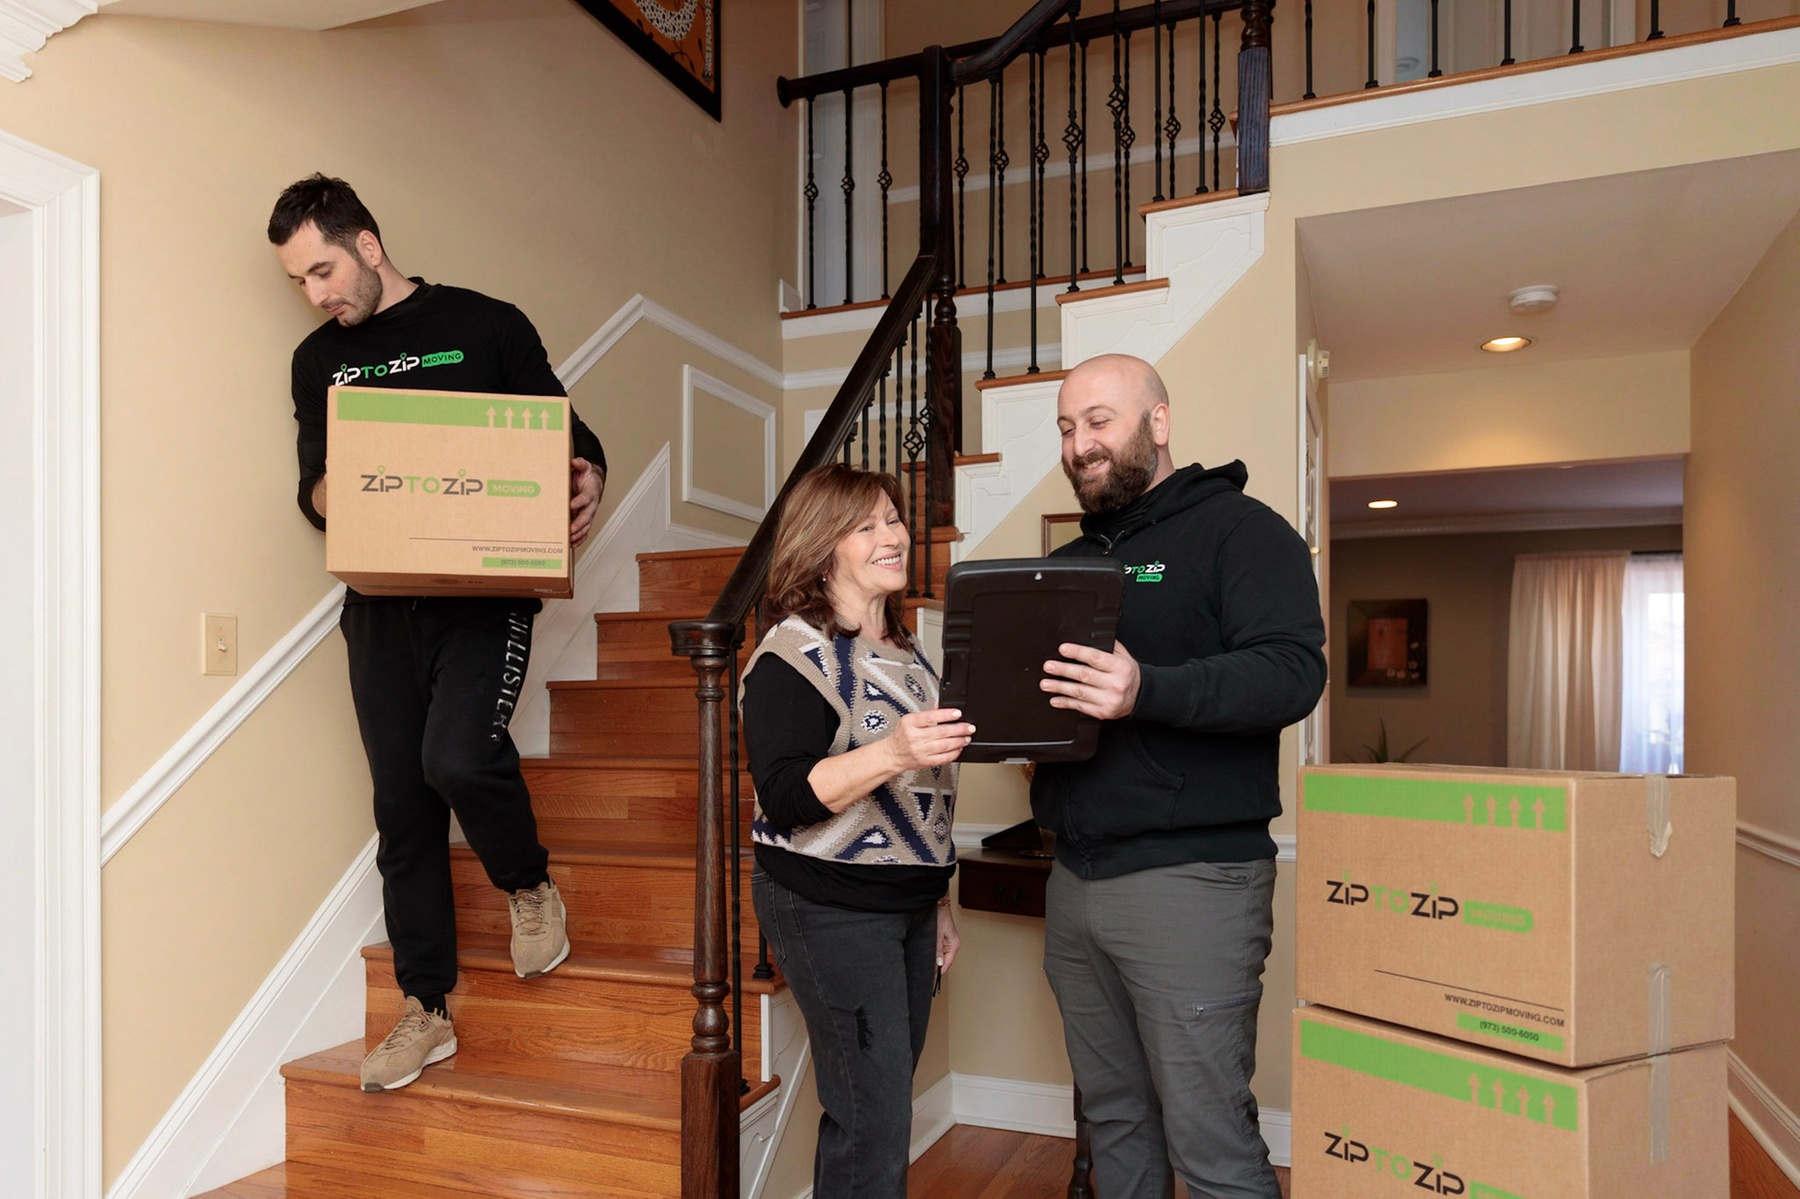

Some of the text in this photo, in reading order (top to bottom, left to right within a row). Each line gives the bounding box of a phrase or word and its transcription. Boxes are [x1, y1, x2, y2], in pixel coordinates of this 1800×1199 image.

[423, 352, 462, 366] MOVING
[492, 484, 535, 495] MOVING
[471, 545, 563, 554] WWW.ZIPTOZIPMOVING.COM
[1444, 993, 1565, 1028] WWW.ZIPTOZIPMOVING.COM
[1479, 1020, 1540, 1041] (973) 500-6050
